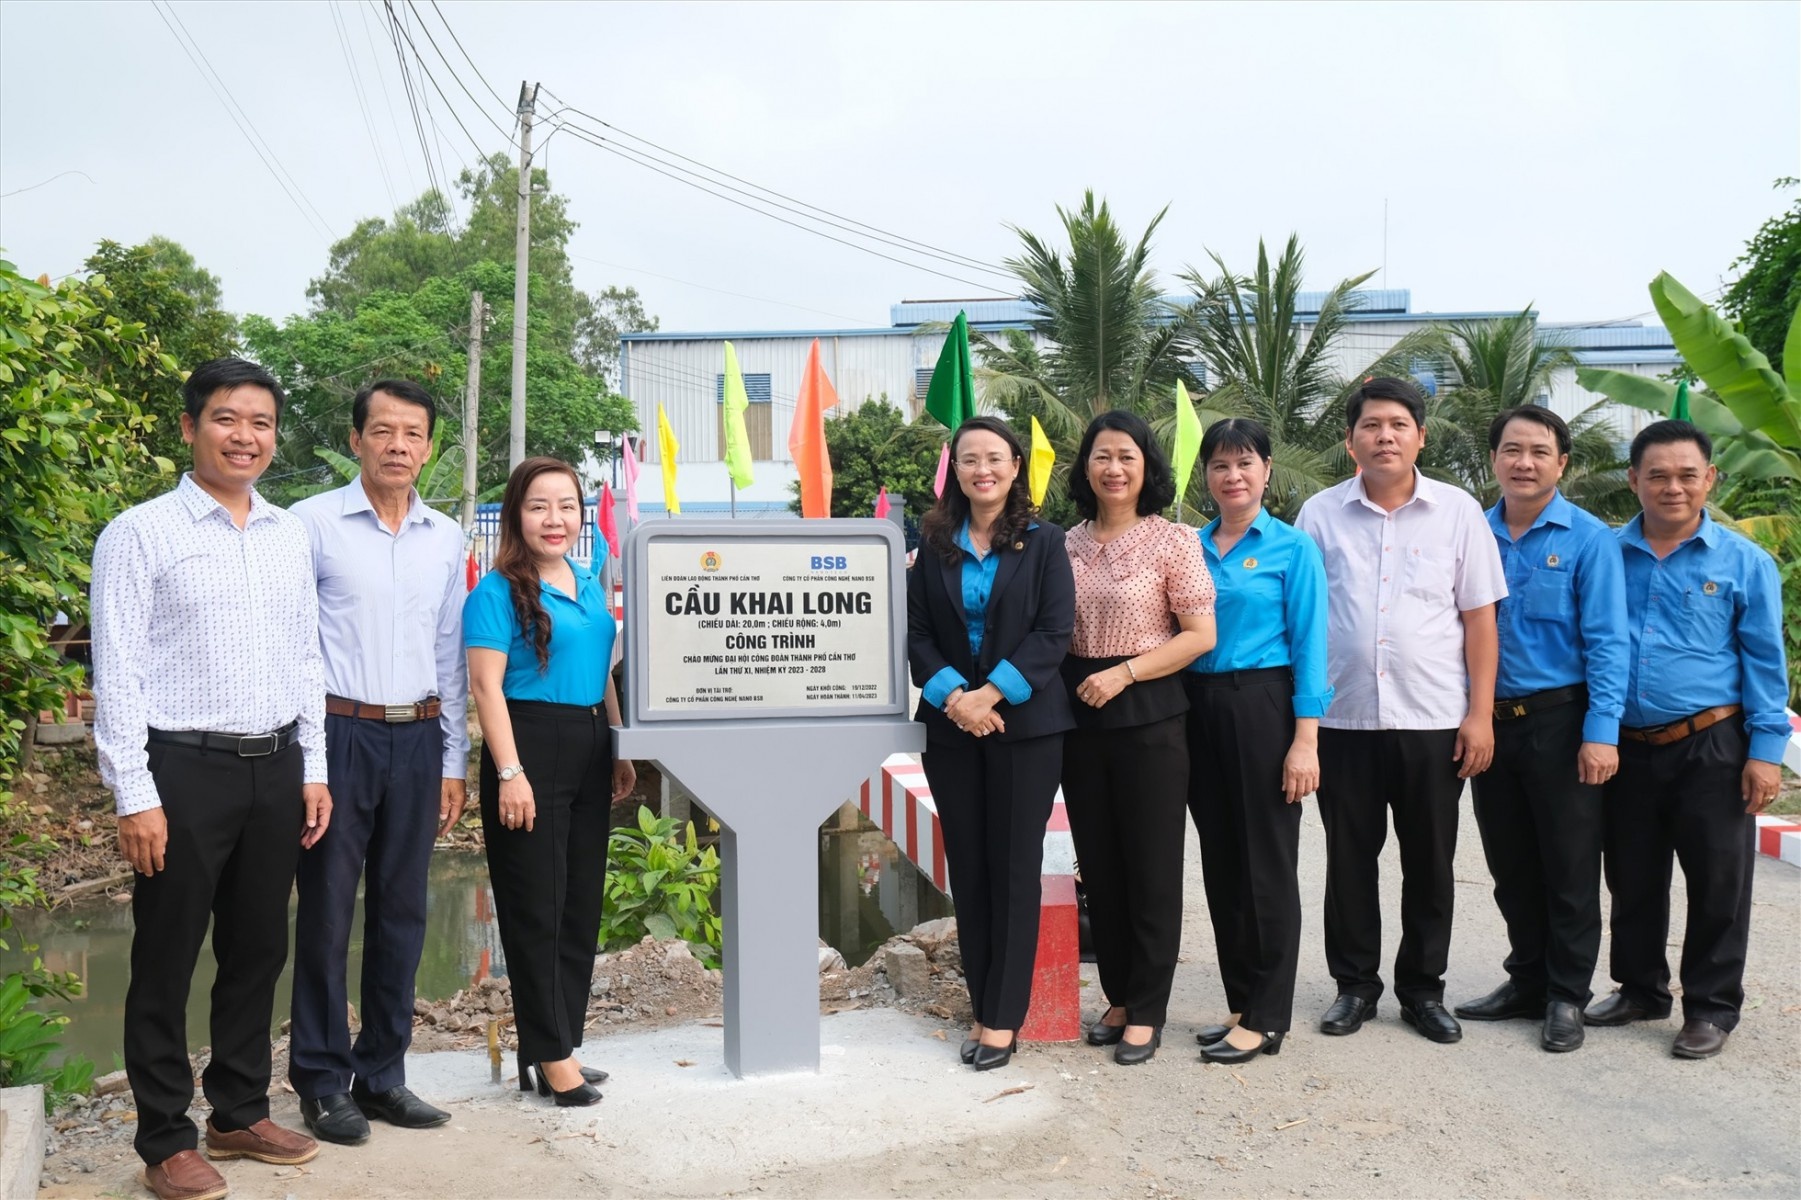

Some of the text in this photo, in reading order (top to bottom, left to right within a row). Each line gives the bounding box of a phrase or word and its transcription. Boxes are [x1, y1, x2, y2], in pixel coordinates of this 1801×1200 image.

[811, 556, 847, 570] BSB
[688, 574, 697, 582] LAO
[782, 574, 796, 582] CÔNG
[665, 584, 872, 616] CẦU KHAI LONG
[698, 617, 724, 629] (CHIỀU
[725, 618, 740, 629] DÀI:
[742, 619, 765, 629] 20,0m
[772, 617, 794, 628] CHIỀU
[796, 618, 819, 629] RỘNG:
[820, 618, 841, 628] 4,0m)
[725, 631, 815, 650] CÔNG TRÌNH
[683, 651, 856, 664] CHÀO MỪNG ĐẠI HỘI CÔNG ĐOÀN THÀNH PHỐ CẦN THƠ
[730, 665, 743, 674] THỨ
[744, 667, 753, 675] XI,
[754, 665, 776, 675] NHIỆM
[778, 664, 787, 674] KỲ
[788, 666, 804, 674] 2023
[810, 665, 826, 673] 2028
